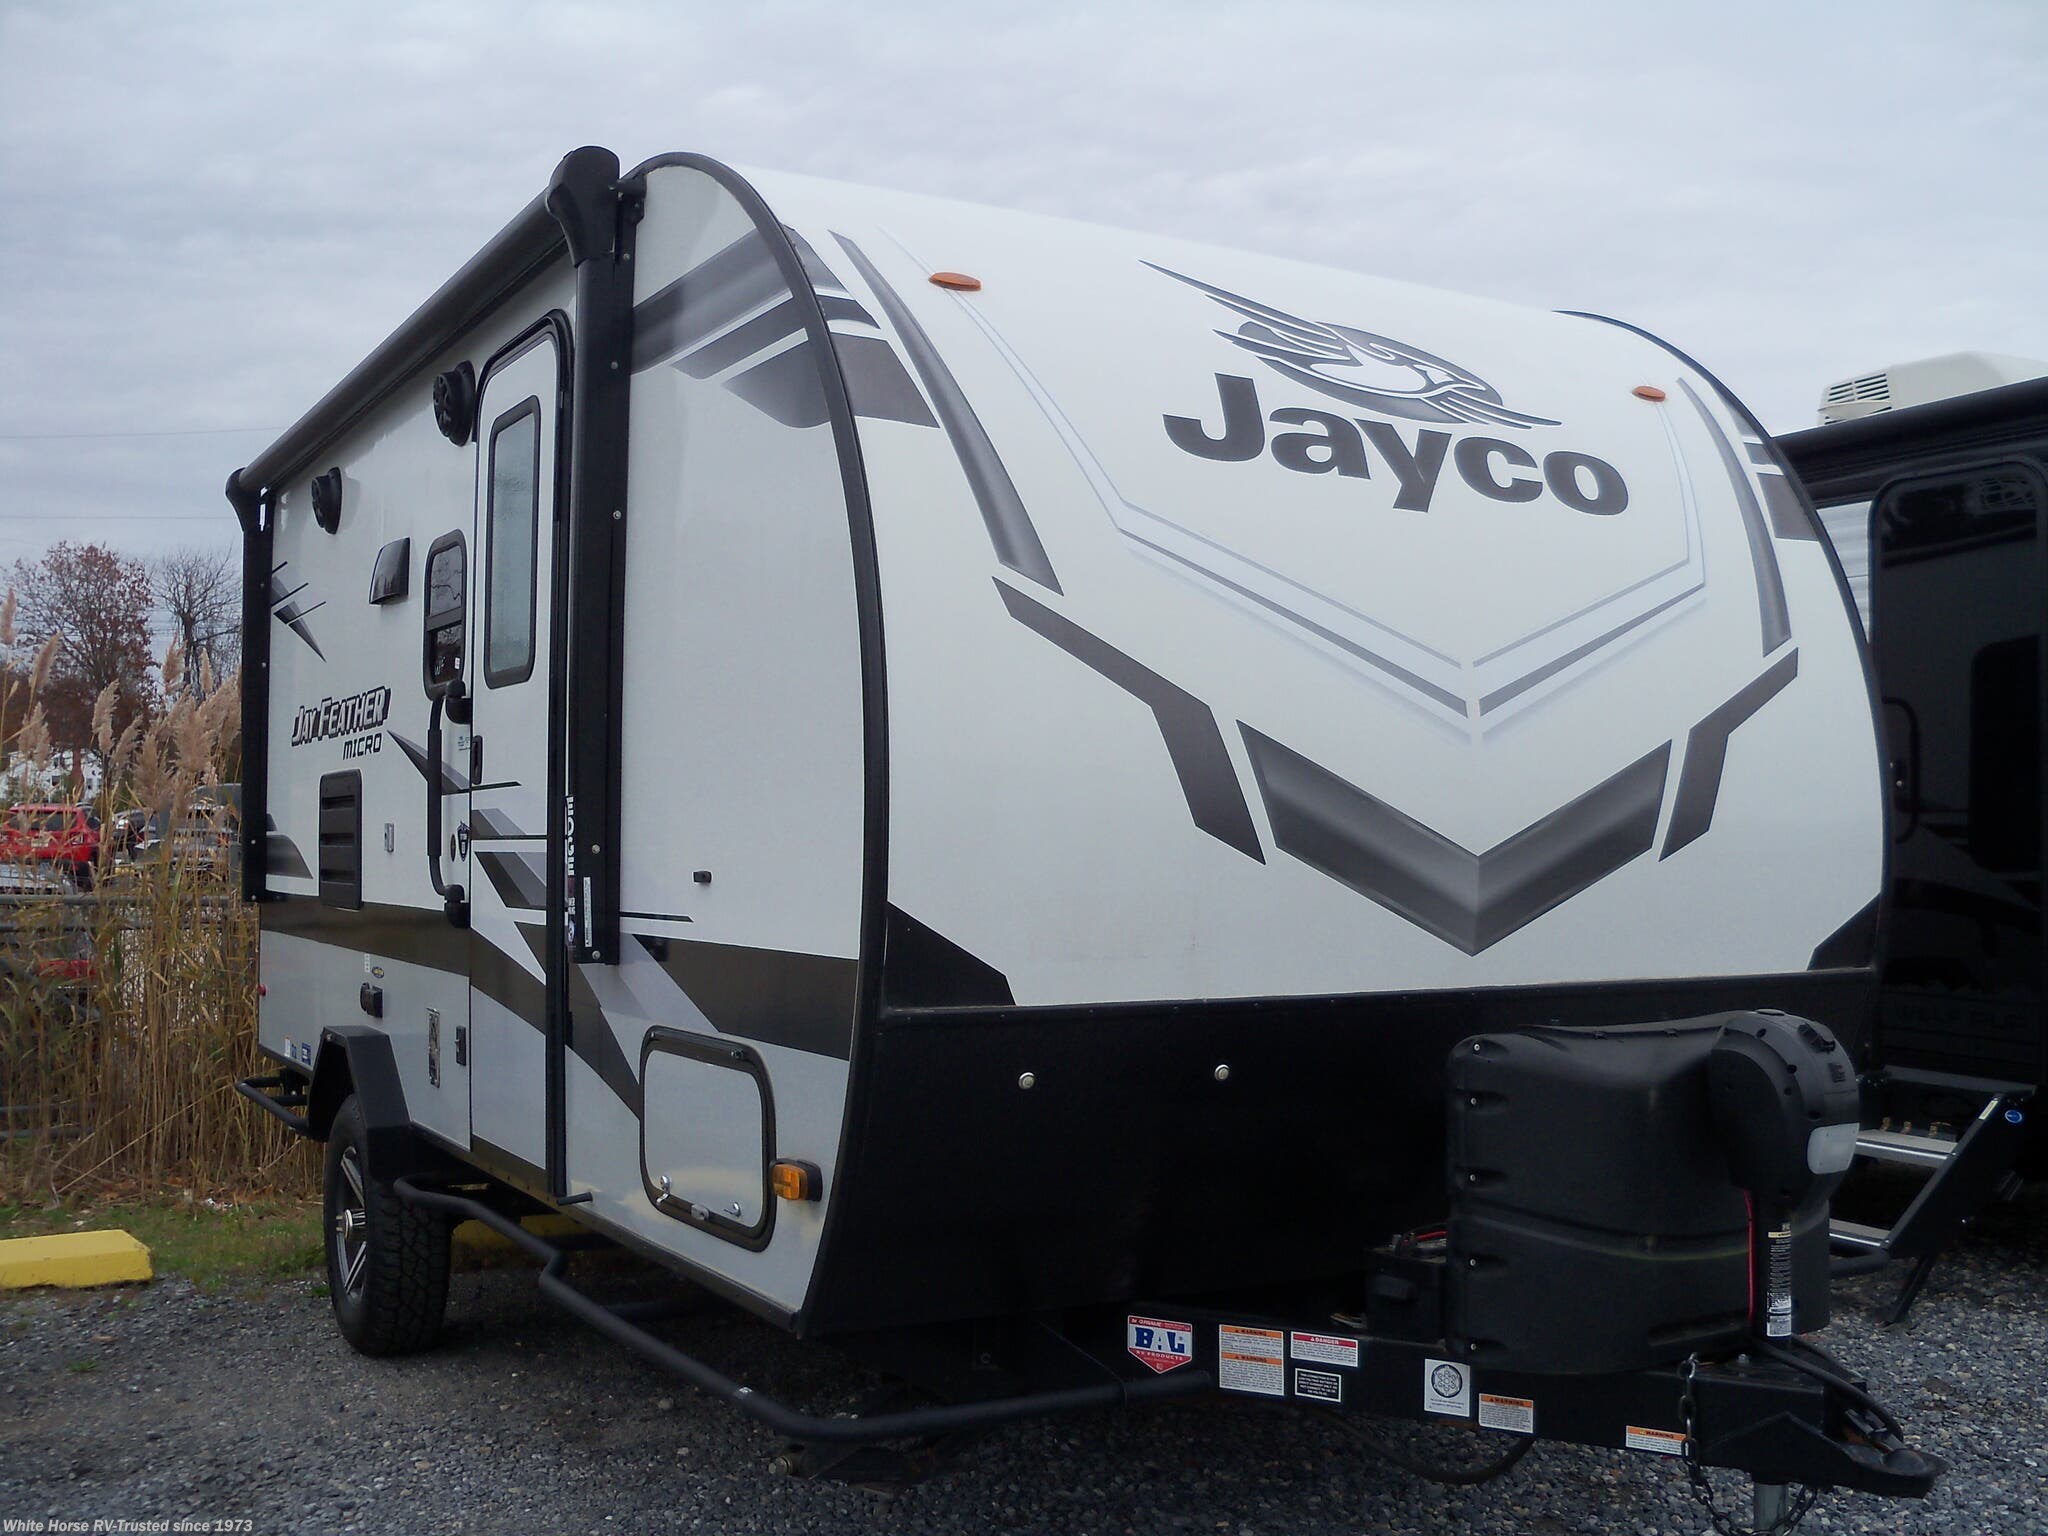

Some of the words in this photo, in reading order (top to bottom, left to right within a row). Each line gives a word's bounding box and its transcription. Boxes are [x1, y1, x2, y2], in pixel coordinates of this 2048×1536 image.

[1163, 372, 1629, 516] Jayco
[292, 705, 317, 747] JAY
[317, 686, 391, 741] FEATHER
[343, 732, 382, 762] MICRO
[1135, 1327, 1185, 1354] BAL
